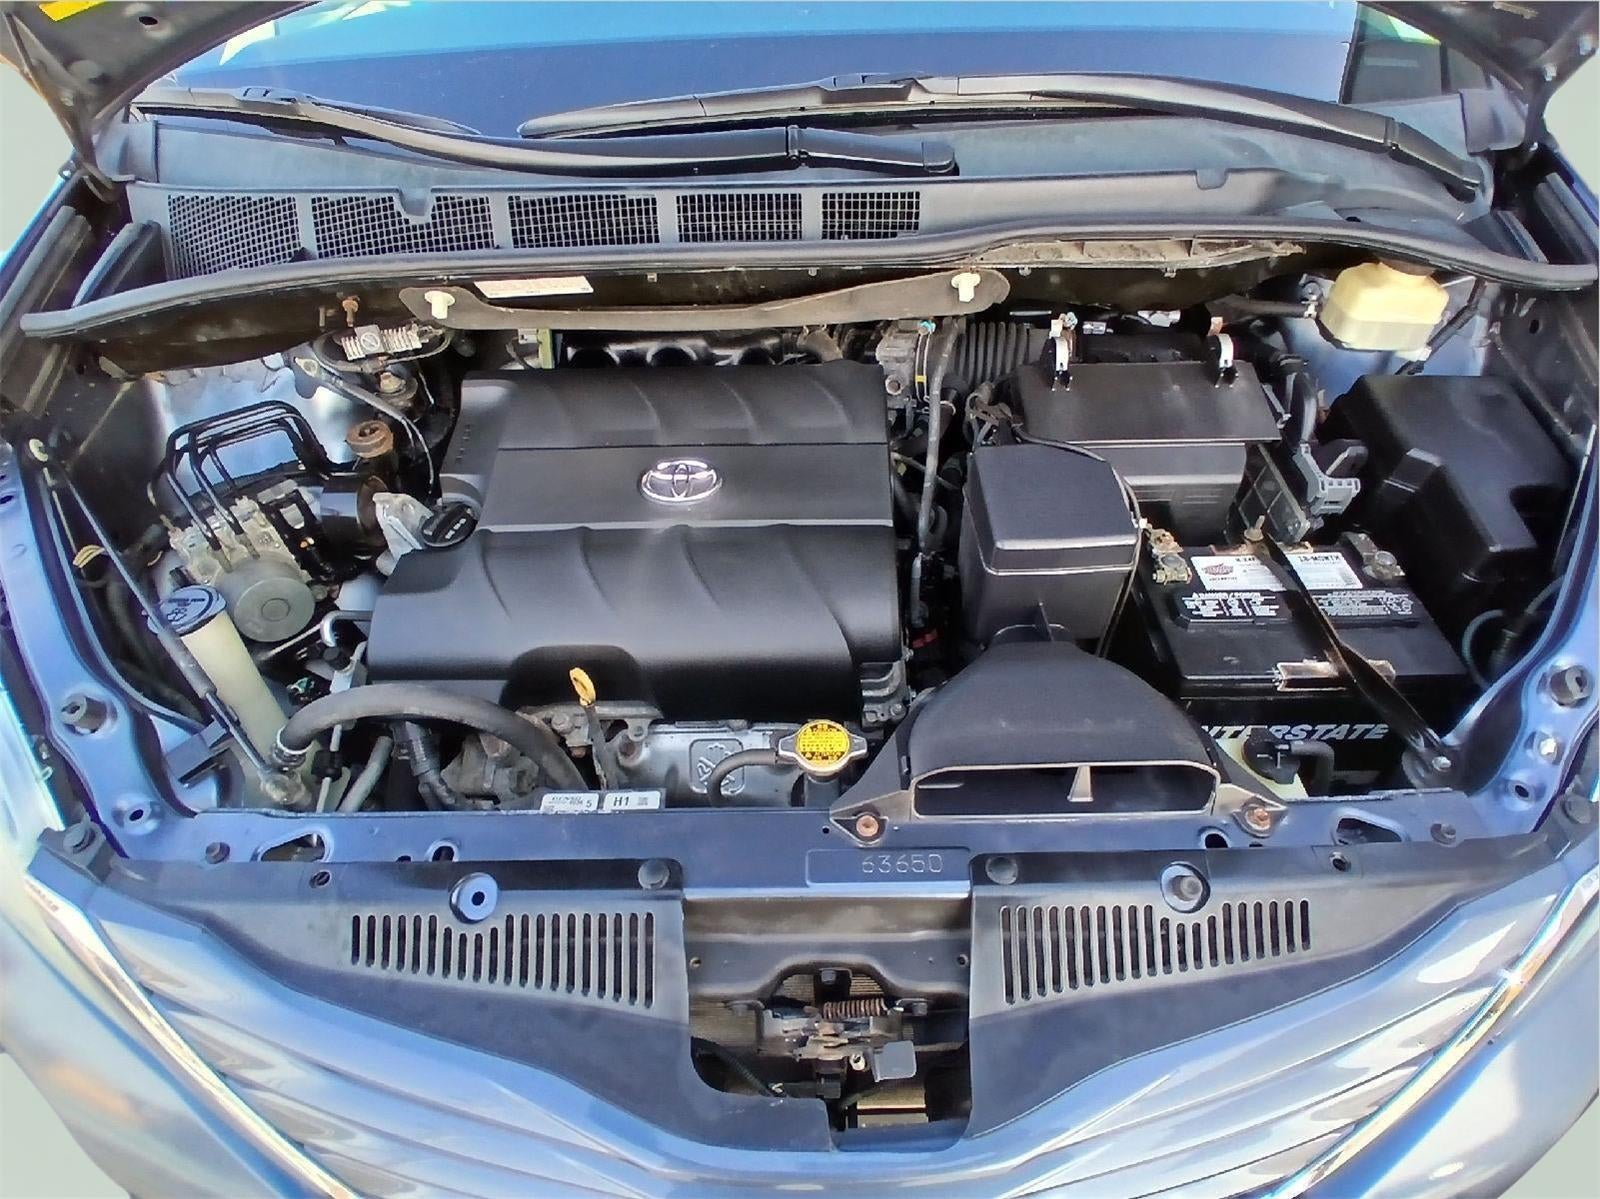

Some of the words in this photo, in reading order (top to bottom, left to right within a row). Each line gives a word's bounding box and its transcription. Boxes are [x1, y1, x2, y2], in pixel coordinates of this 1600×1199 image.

[1201, 724, 1390, 741] TERSTATE
[585, 799, 593, 809] 5
[613, 797, 630, 807] H1
[862, 853, 944, 873] 63650
